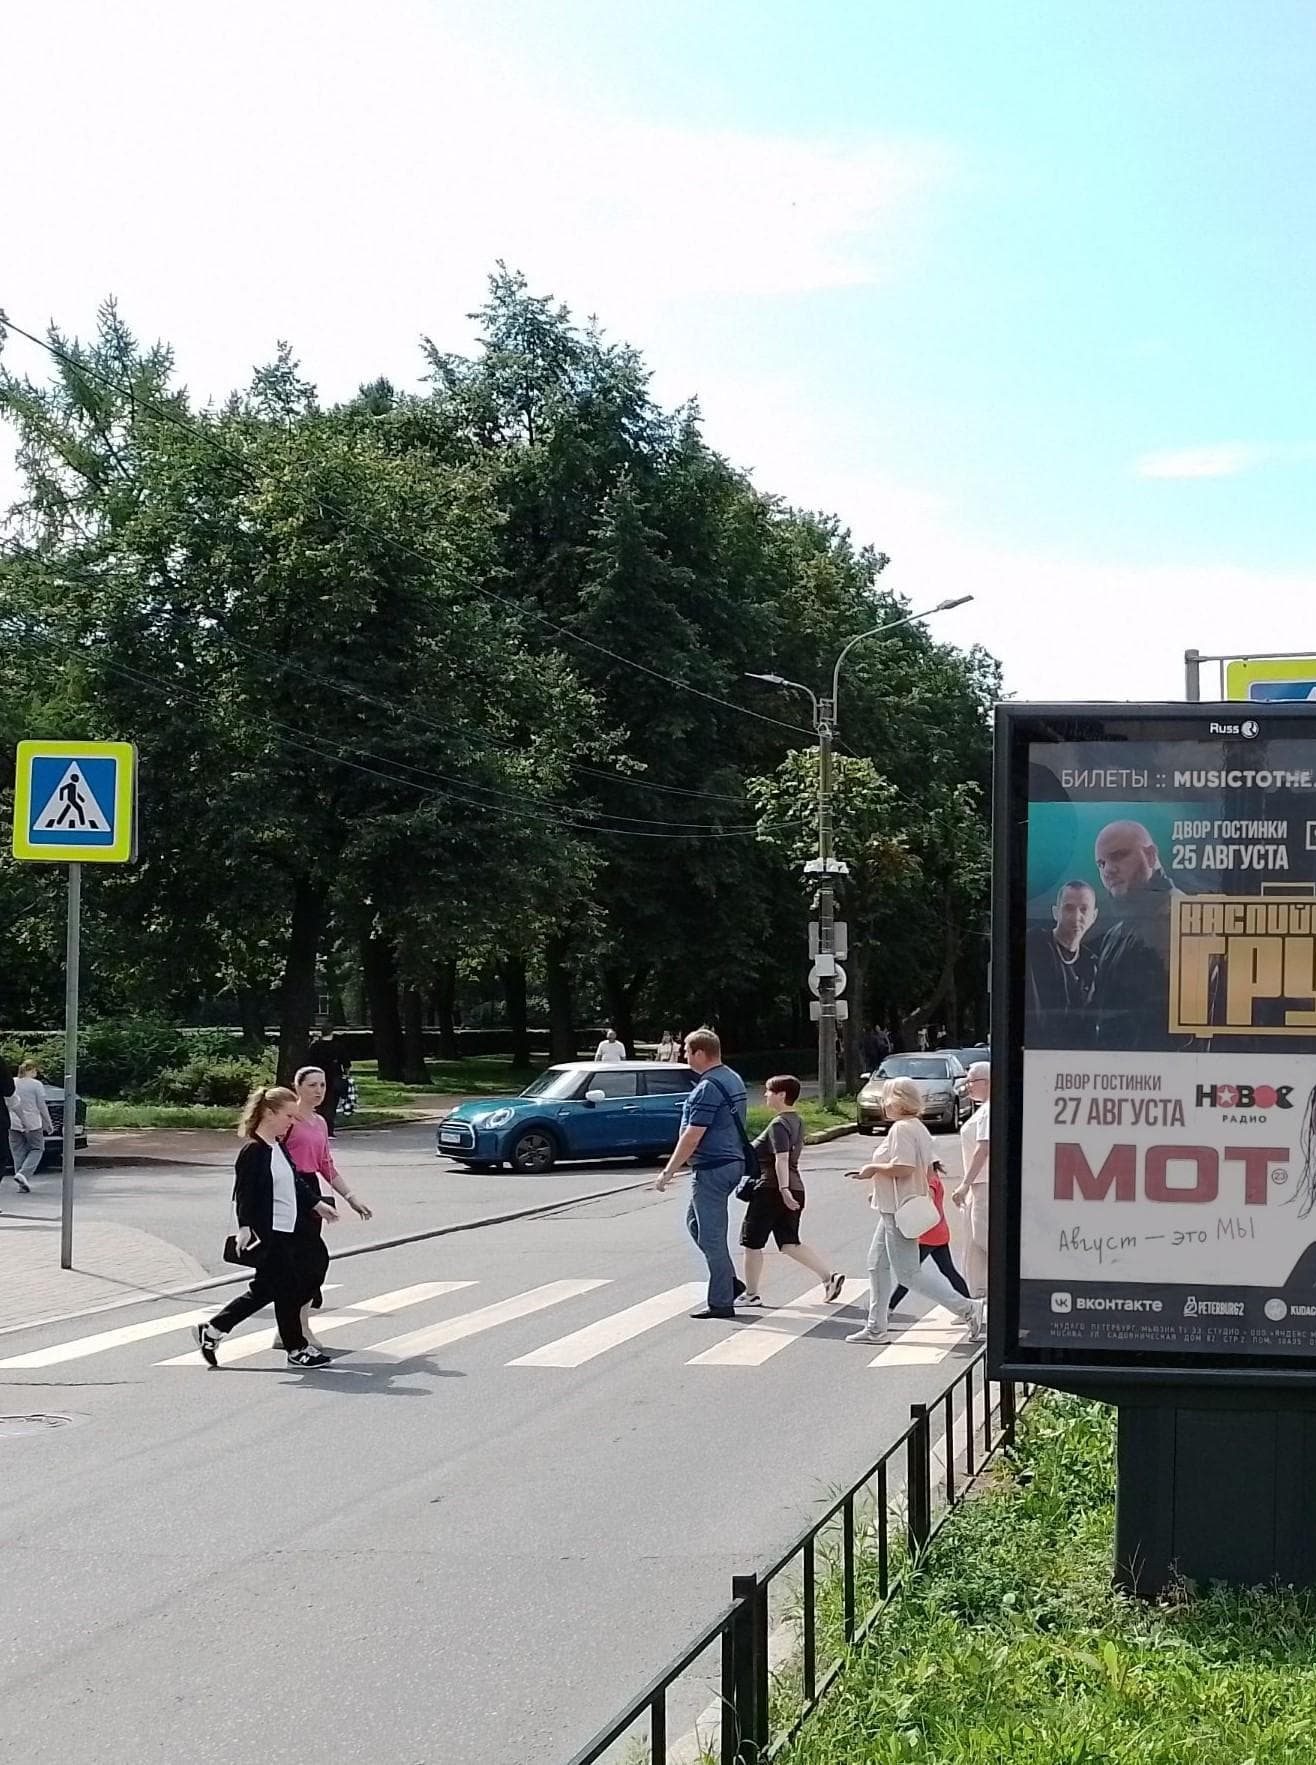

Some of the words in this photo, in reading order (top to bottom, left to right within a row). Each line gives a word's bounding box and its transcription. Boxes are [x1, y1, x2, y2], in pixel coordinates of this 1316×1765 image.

[1209, 722, 1240, 735] Russ
[1061, 769, 1148, 788] БИЛЕТЫ
[1171, 820, 1211, 841] ДВОР
[1213, 820, 1288, 840] ГОСТИНКИ
[1171, 844, 1198, 871] 25
[1201, 844, 1290, 871] АВГУСТА
[1054, 1073, 1091, 1092] ДВОР
[1093, 1074, 1162, 1092] ГОСТИНКИ
[1053, 1097, 1082, 1126] 27
[1086, 1097, 1186, 1128] АВГУСТА
[1222, 1114, 1267, 1124] РАДИО
[1053, 1142, 1290, 1206] МОТ
[1059, 1226, 1137, 1264] Август
[1171, 1230, 1208, 1246] это
